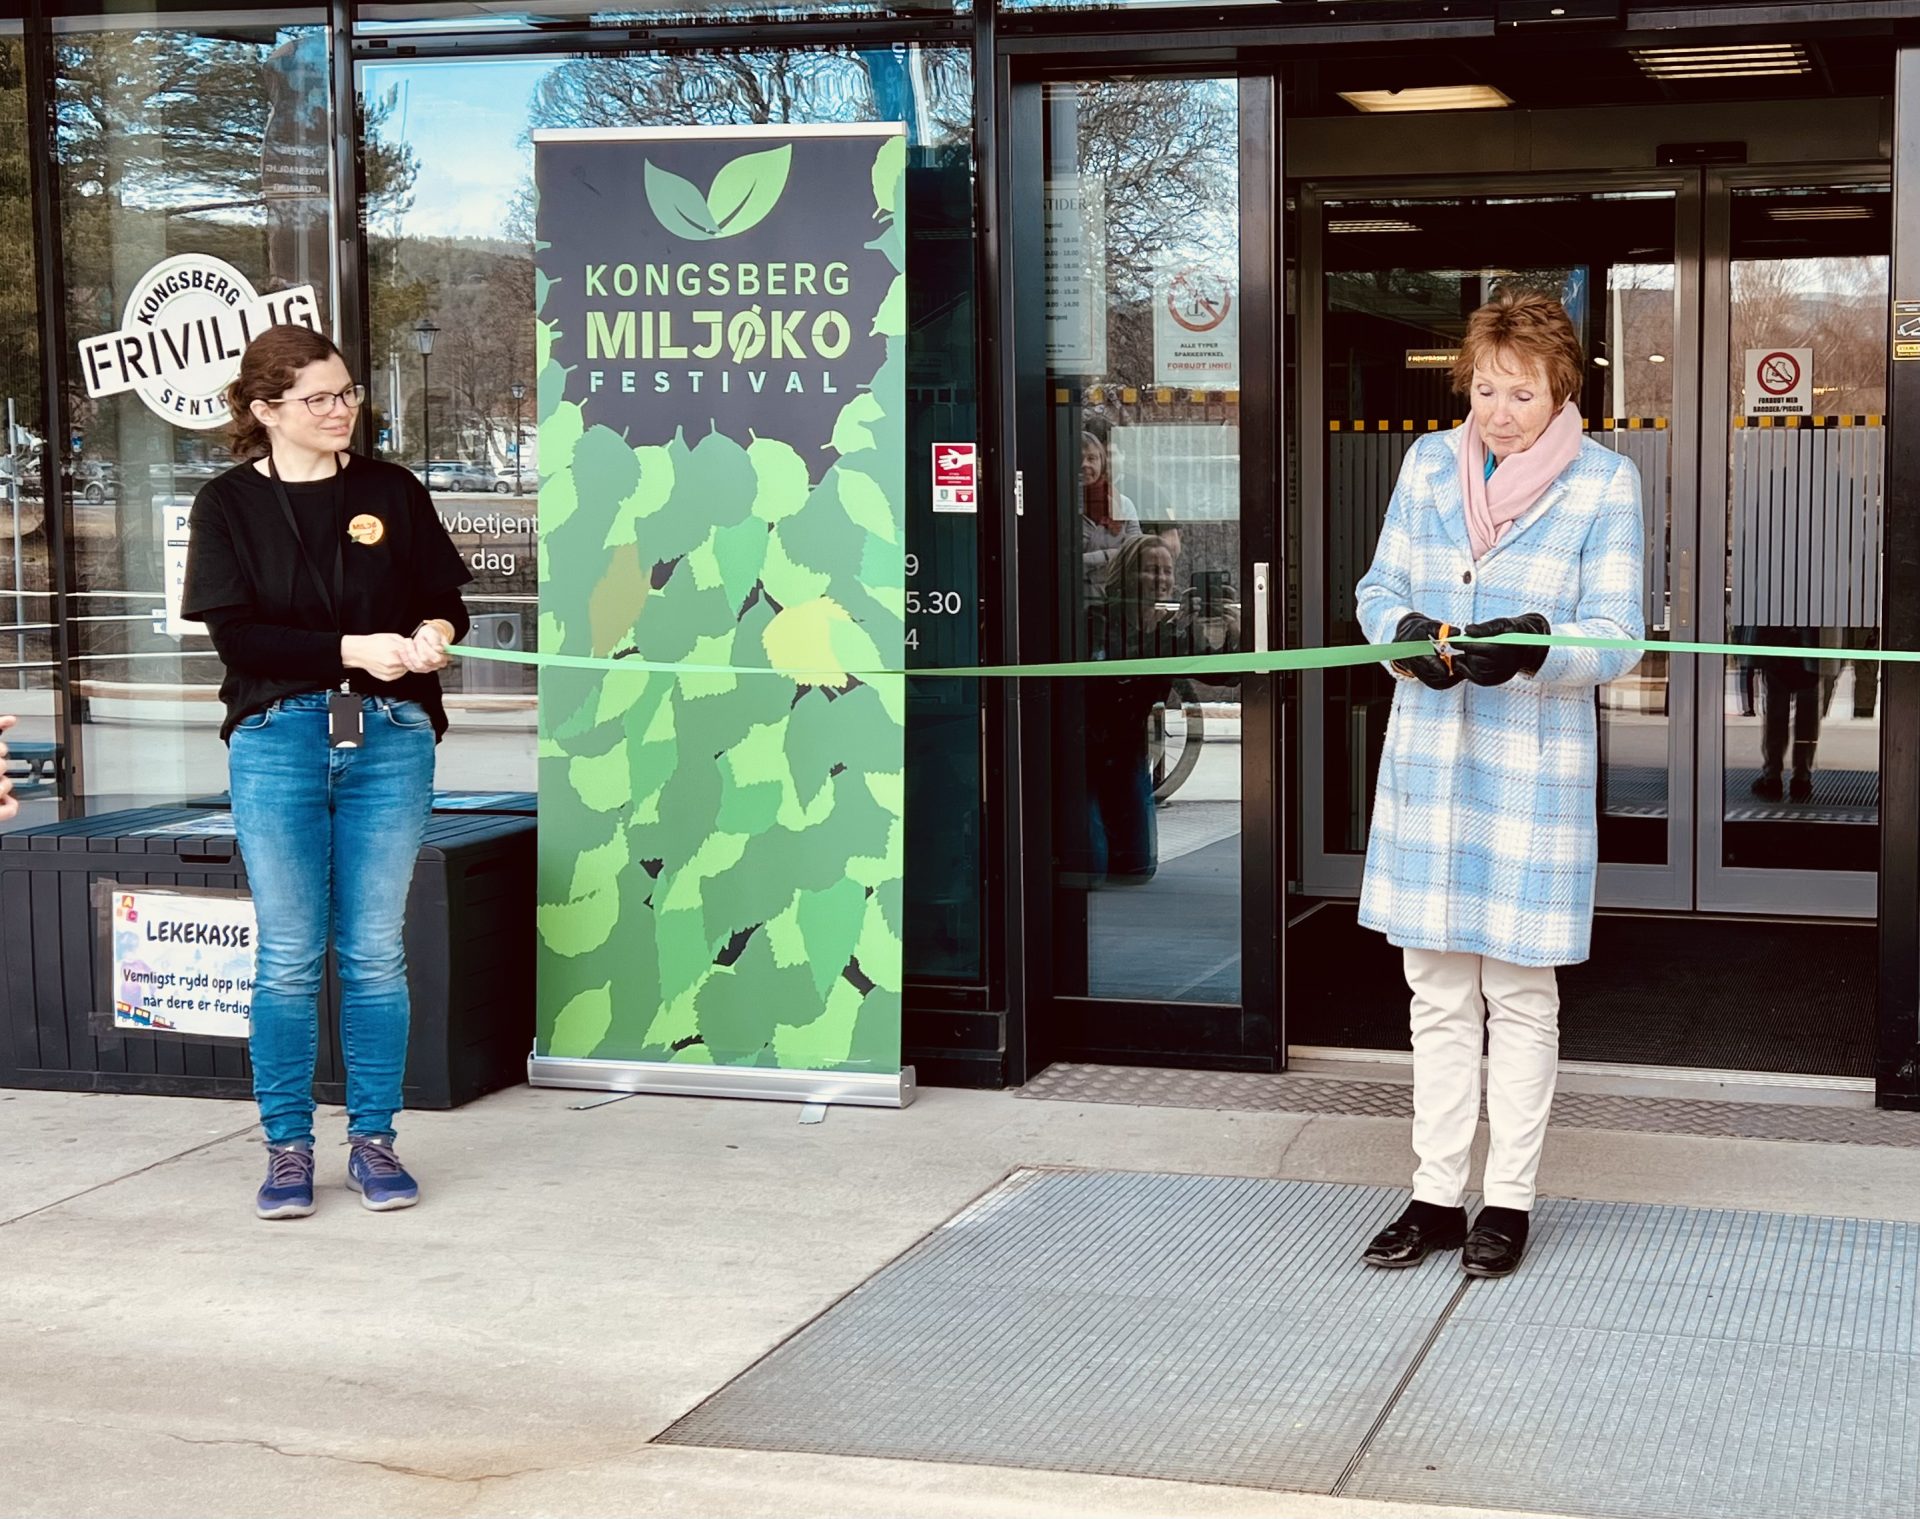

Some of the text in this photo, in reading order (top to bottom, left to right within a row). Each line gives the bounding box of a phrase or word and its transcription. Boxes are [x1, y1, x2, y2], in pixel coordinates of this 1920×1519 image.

[585, 261, 850, 297] KONGSBERG
[137, 270, 241, 326] KONGSBERG
[585, 303, 851, 365] MILJØKO
[589, 370, 838, 394] FESTIVAL
[160, 388, 229, 416] SENTR
[471, 548, 516, 576] dag
[147, 920, 250, 948] LEKEKASSE
[123, 969, 176, 989] Vennligst
[179, 974, 209, 991] rydd
[212, 978, 233, 994] opp
[167, 996, 194, 1010] dere
[198, 1001, 212, 1010] er
[214, 999, 250, 1019] ferdig
